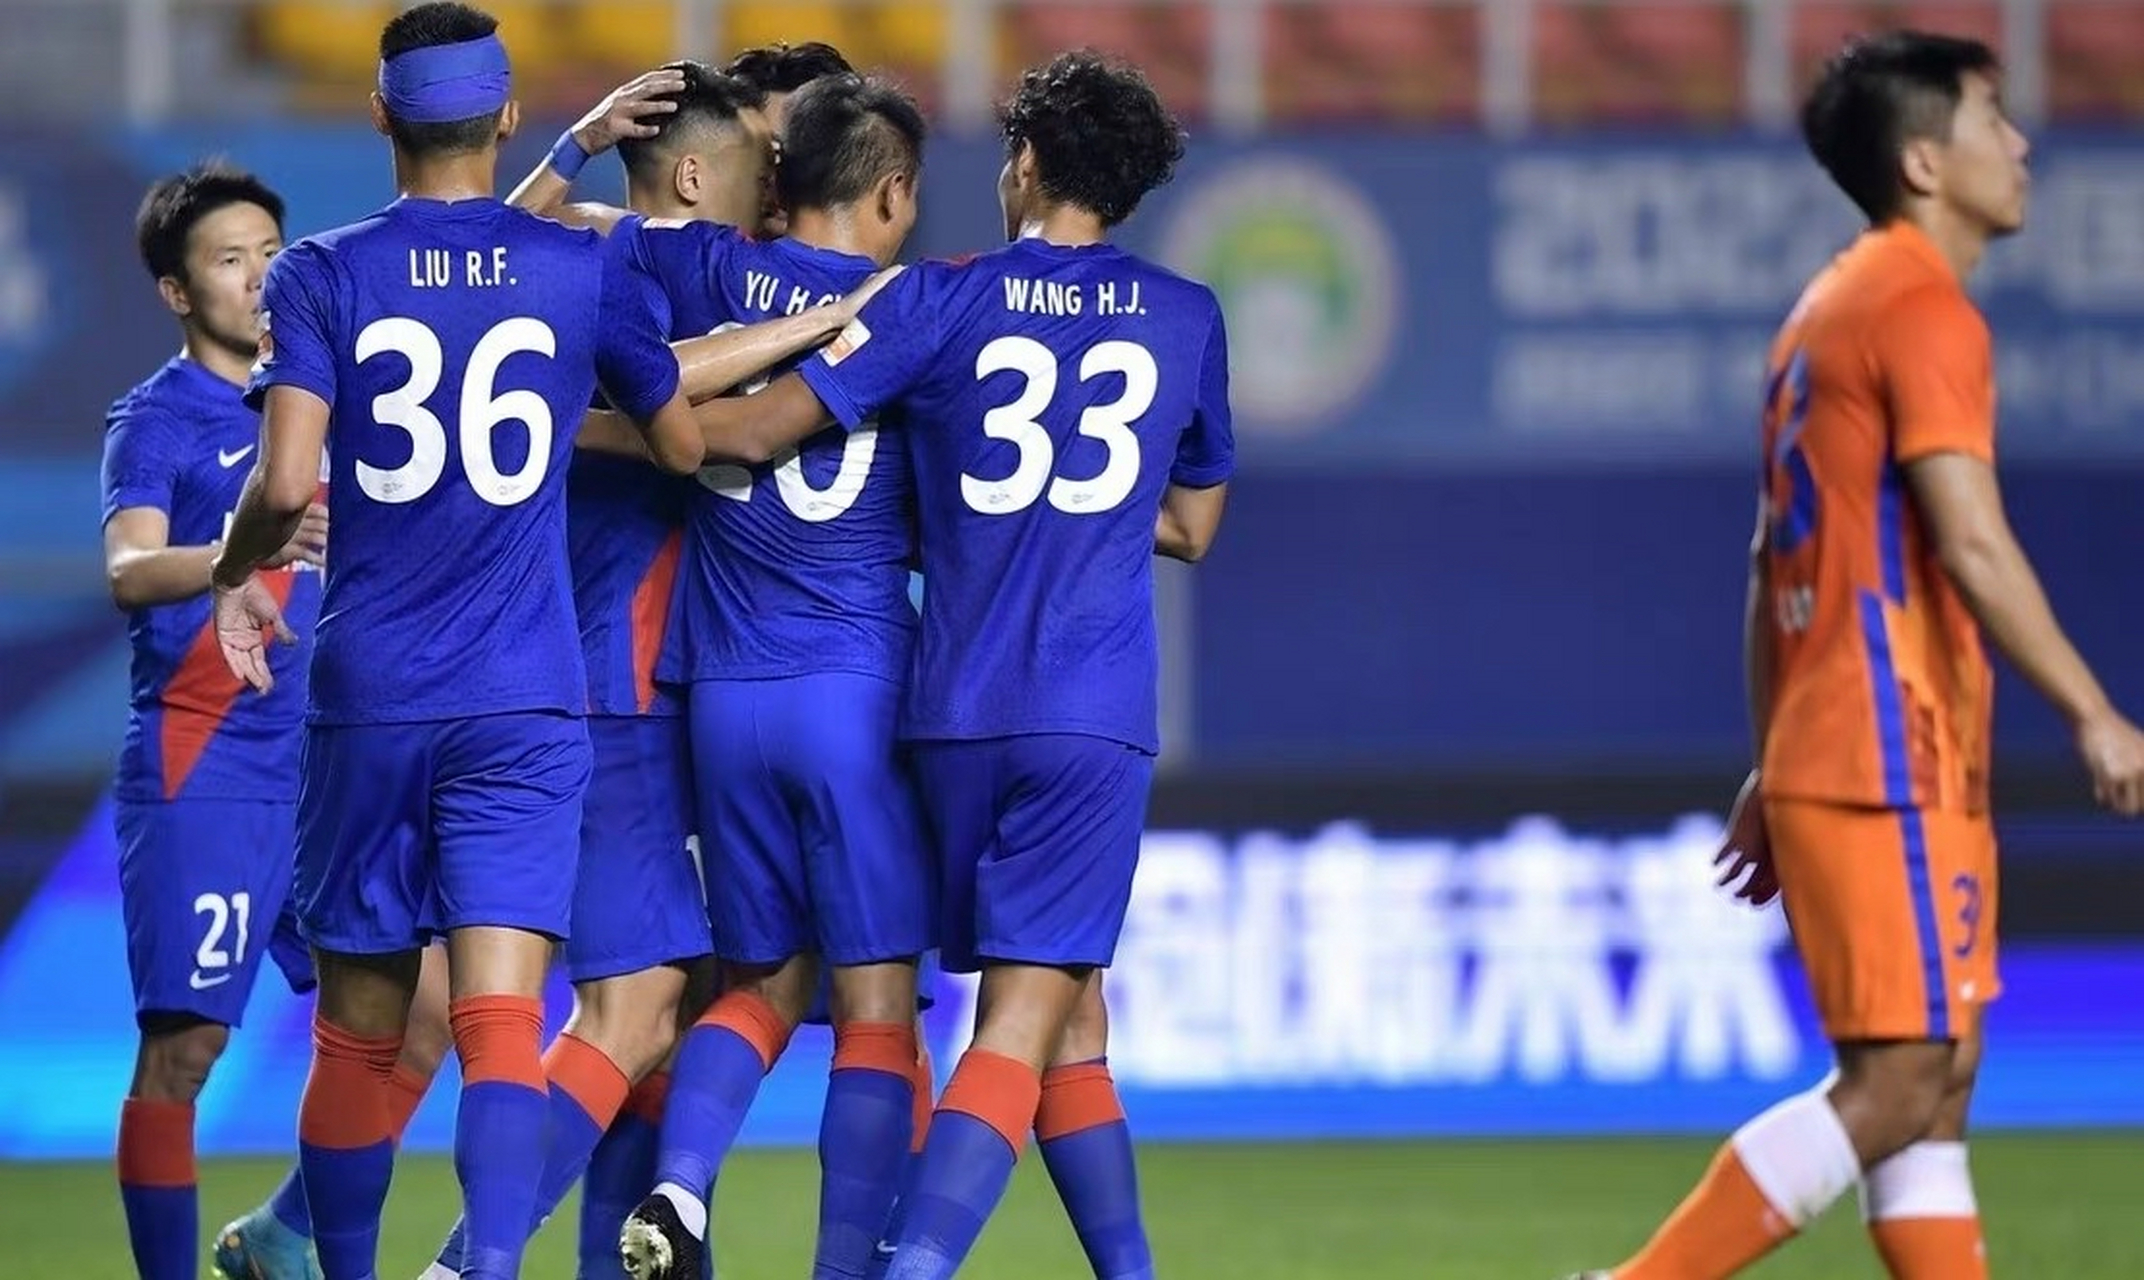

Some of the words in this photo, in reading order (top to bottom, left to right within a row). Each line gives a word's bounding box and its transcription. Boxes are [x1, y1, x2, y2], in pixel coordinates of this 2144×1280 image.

[409, 248, 450, 288] LIU
[466, 246, 517, 287] R.F.
[744, 270, 780, 312] YU
[1003, 276, 1082, 315] WANG
[1097, 281, 1147, 315] H.J.
[354, 316, 557, 507] 36
[959, 335, 1160, 515] 33
[193, 891, 250, 969] 21
